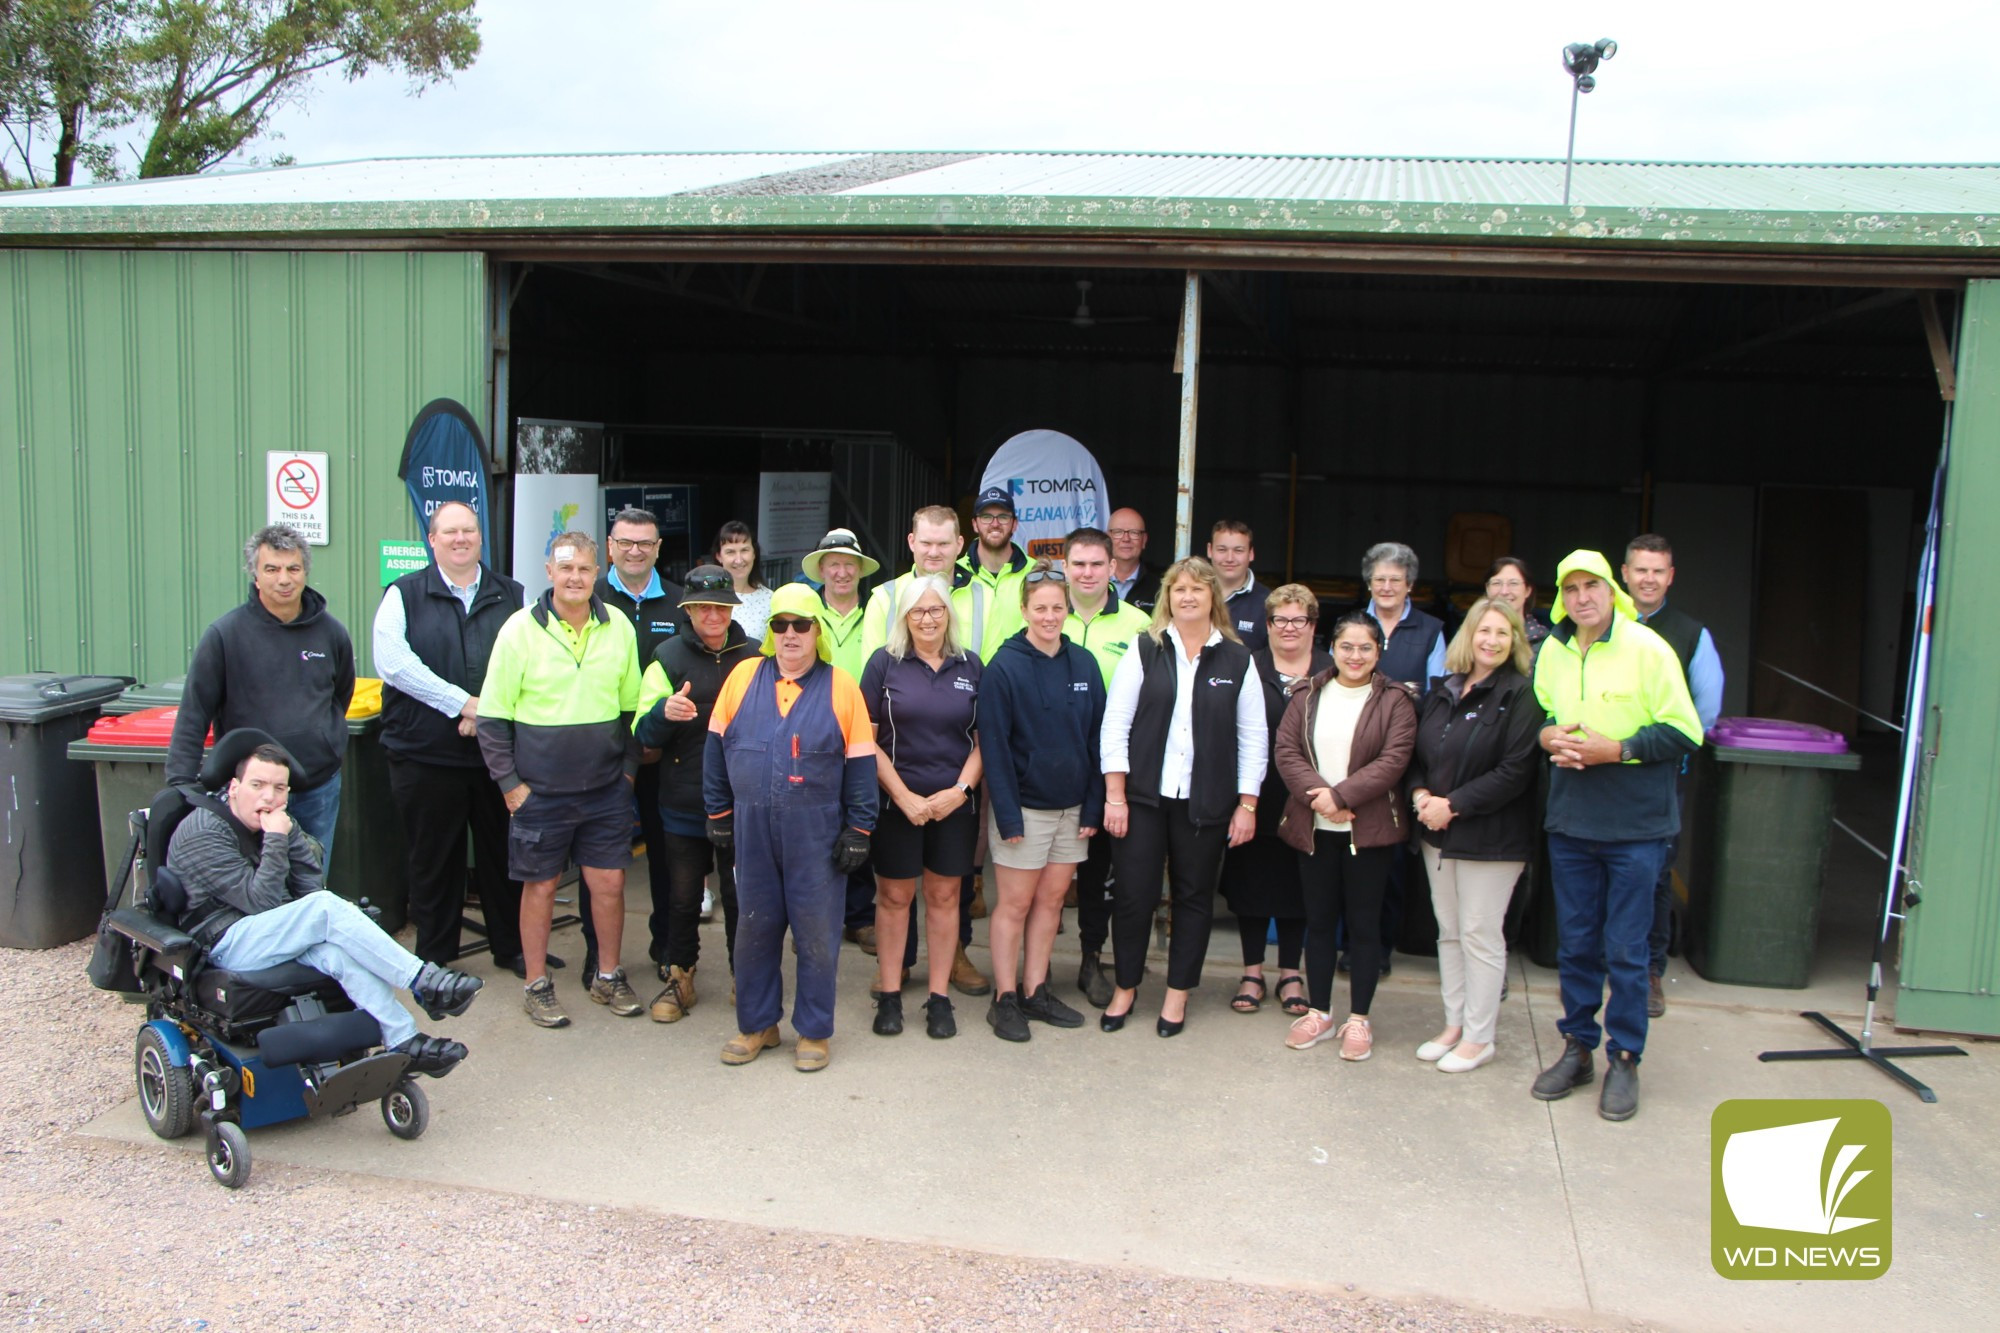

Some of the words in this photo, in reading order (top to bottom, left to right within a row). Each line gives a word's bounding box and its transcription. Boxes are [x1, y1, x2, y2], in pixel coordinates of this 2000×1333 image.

[435, 469, 479, 488] TOMRA
[1026, 478, 1097, 494] TOMRA
[281, 512, 299, 520] THIS
[274, 520, 301, 529] SMOKE
[303, 522, 322, 530] FREE
[382, 545, 428, 557] EMERGEN
[1033, 543, 1065, 556] WEST
[386, 559, 429, 570] ASSEMB
